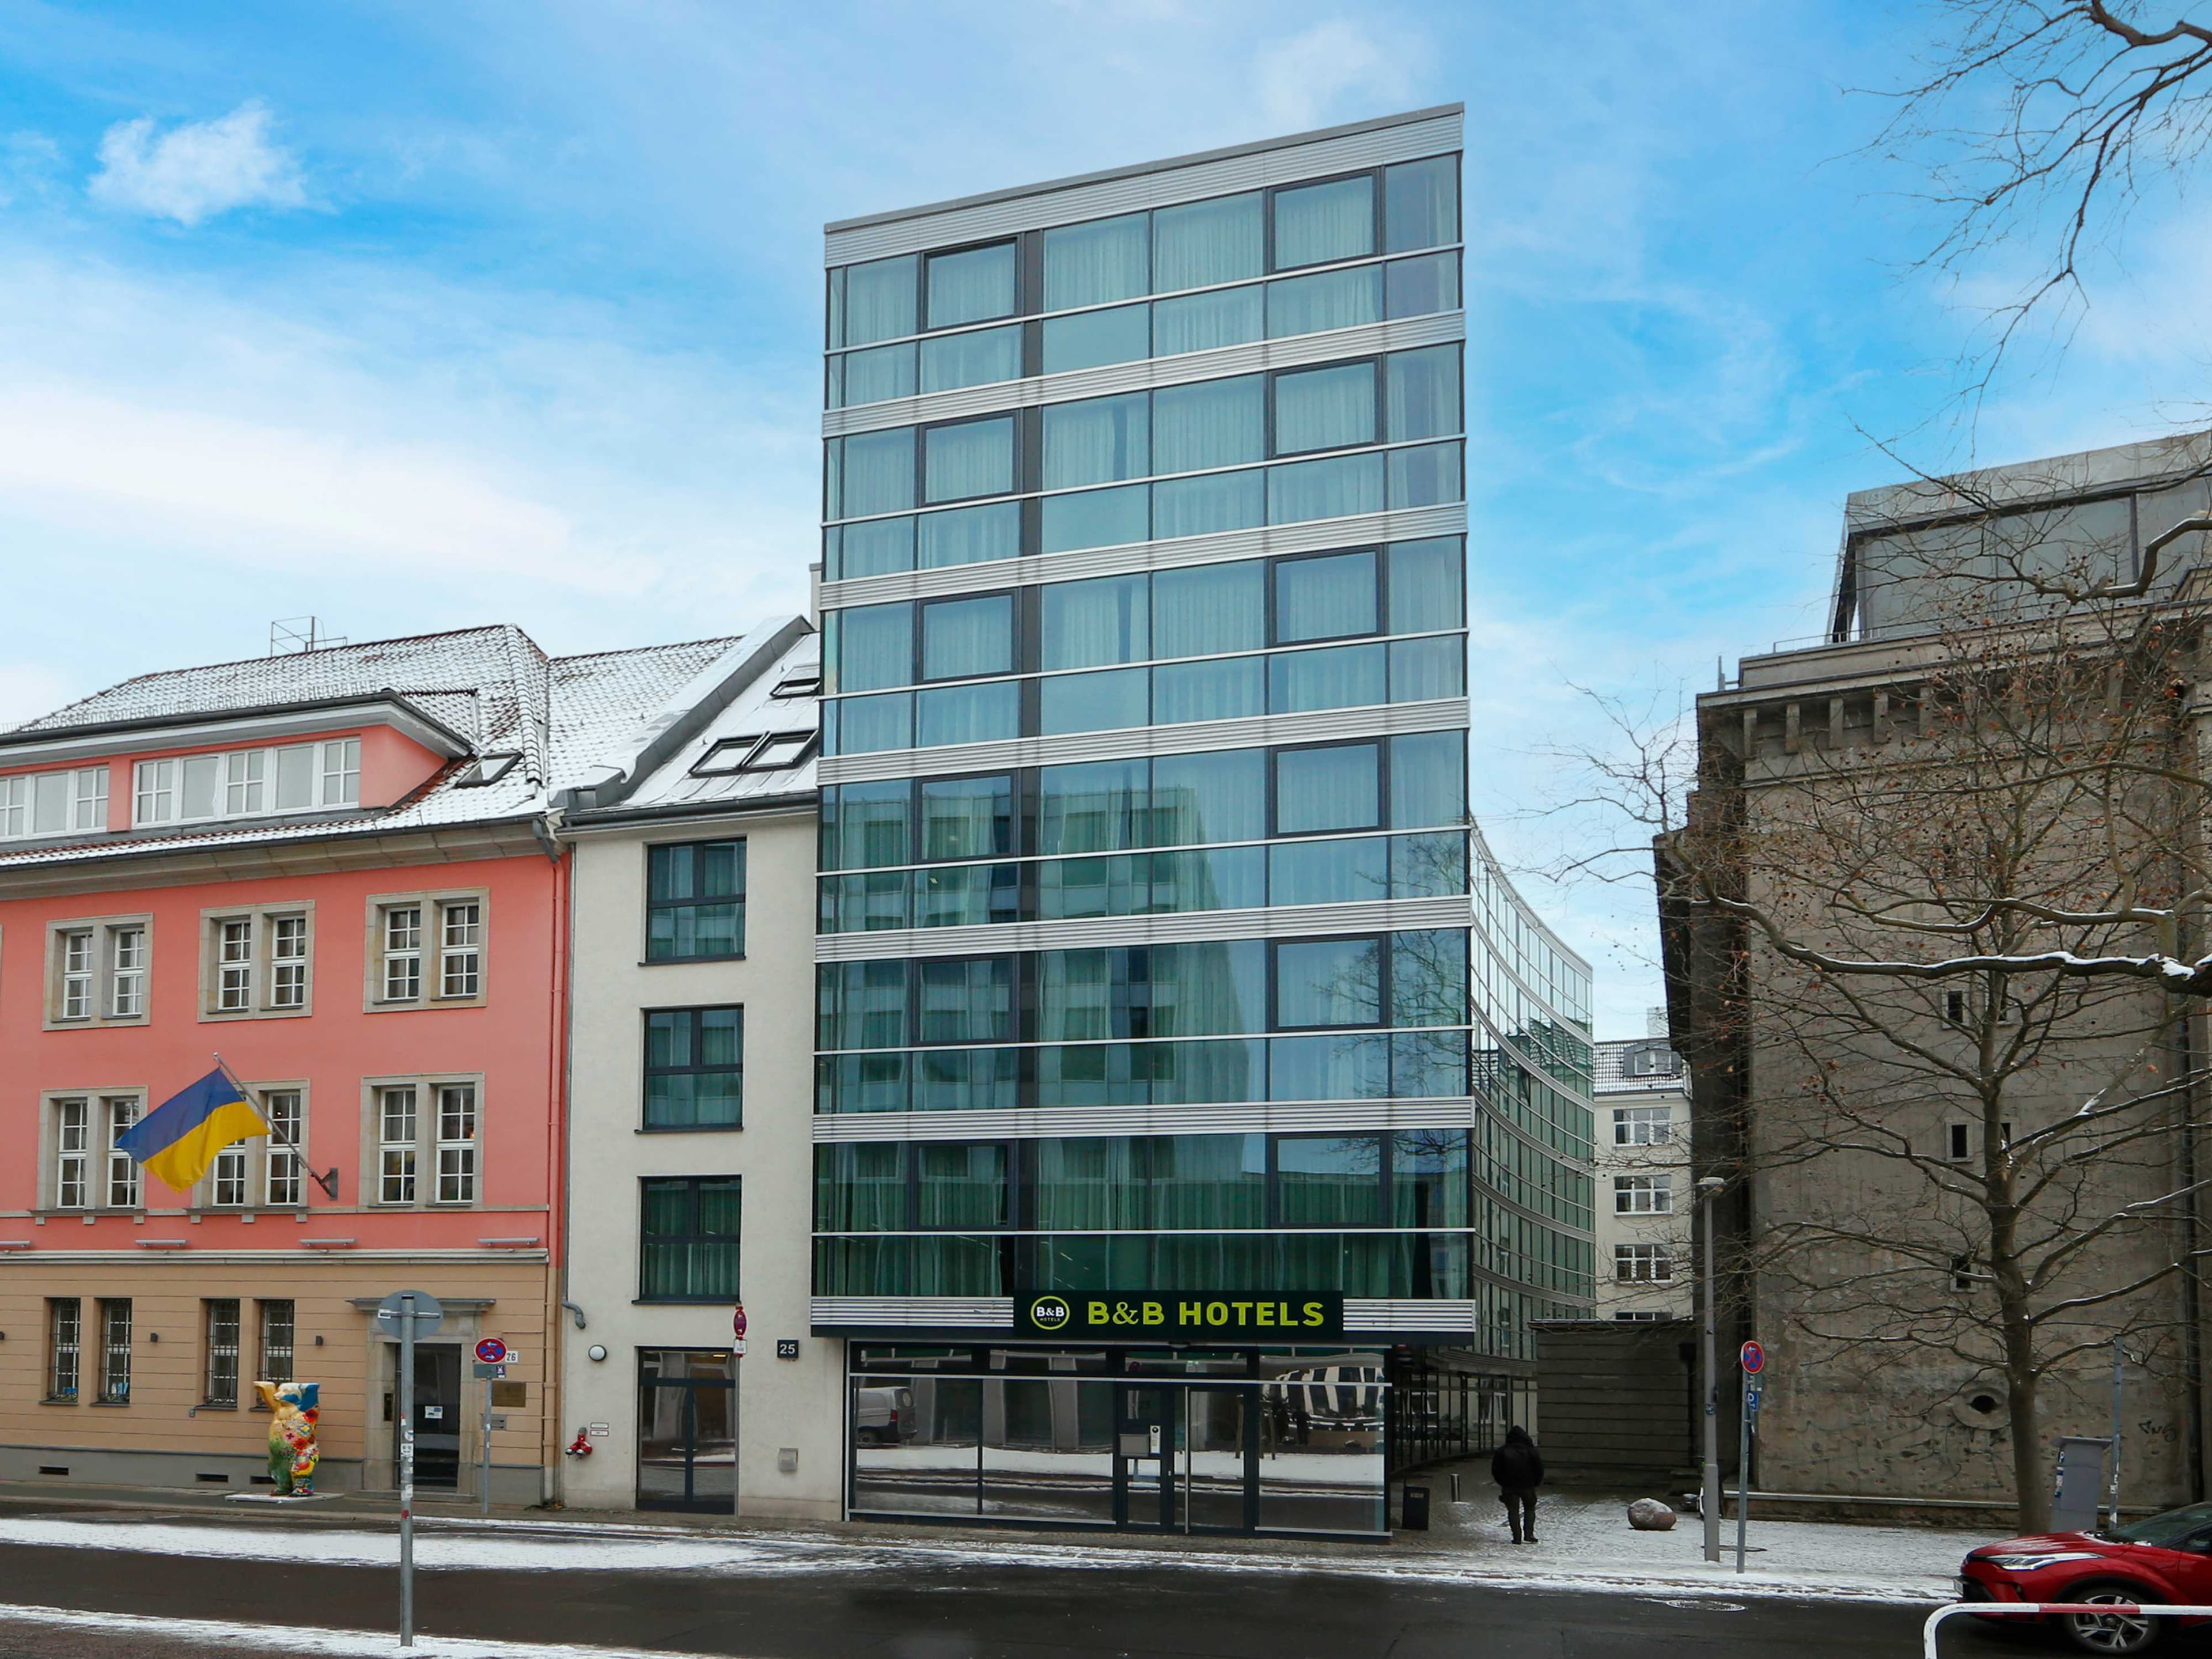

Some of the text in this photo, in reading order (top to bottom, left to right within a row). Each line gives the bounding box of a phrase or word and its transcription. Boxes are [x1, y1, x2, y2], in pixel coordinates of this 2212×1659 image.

[1036, 1306, 1065, 1317] B&B
[1088, 1301, 1324, 1326] B&B HOTELS
[779, 1344, 796, 1354] 25
[506, 1353, 516, 1361] 26
